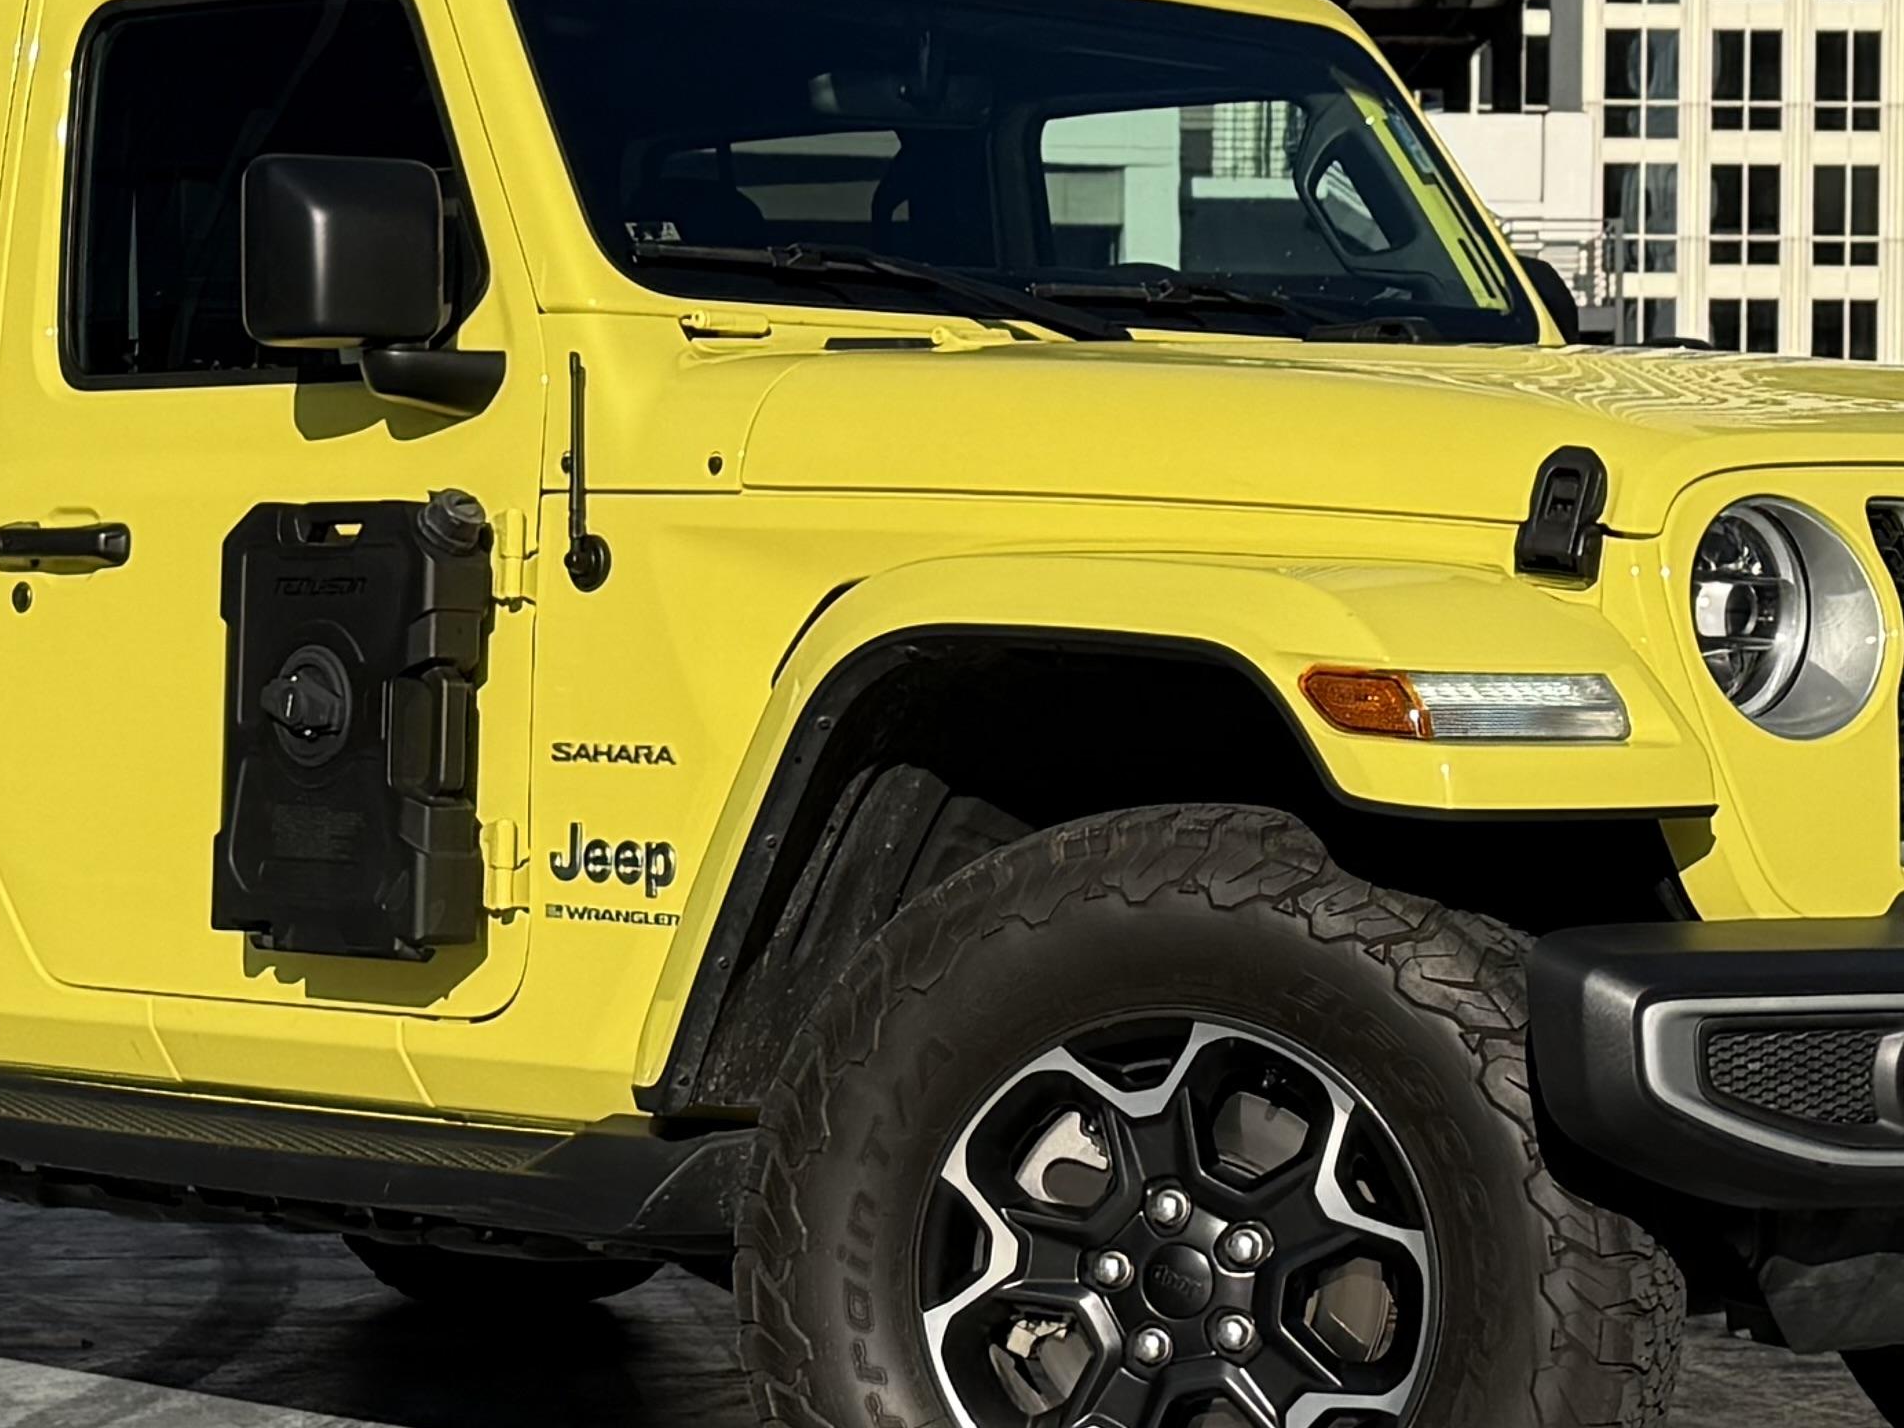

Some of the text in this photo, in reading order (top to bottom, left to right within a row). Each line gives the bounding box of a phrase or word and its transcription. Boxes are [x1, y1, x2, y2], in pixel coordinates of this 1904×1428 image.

[551, 742, 676, 765] SAHARA
[549, 822, 677, 898] Jeep
[565, 905, 680, 926] WRANGLER
